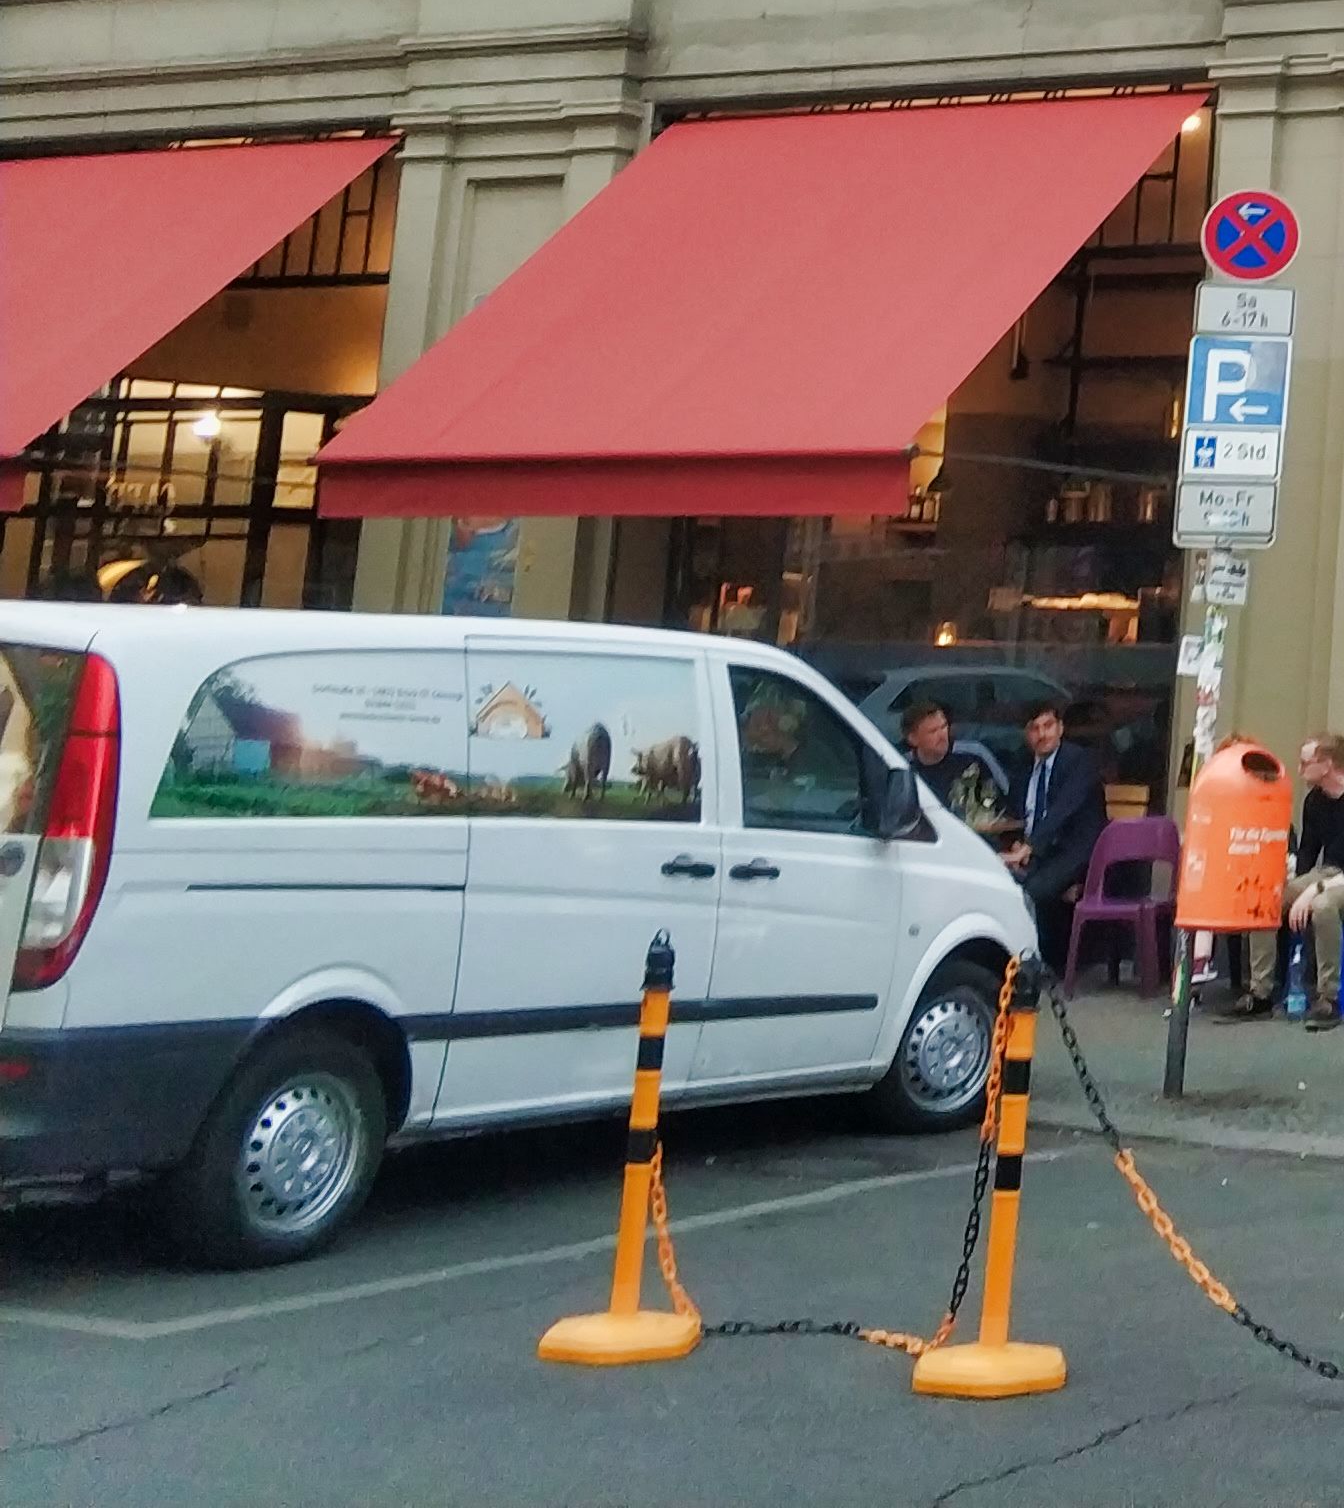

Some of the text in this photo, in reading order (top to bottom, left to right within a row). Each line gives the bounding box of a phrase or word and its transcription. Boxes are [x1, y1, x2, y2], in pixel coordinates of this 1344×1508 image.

[1236, 292, 1257, 309] Sa
[1202, 348, 1257, 423] P
[1223, 442, 1234, 459] 2
